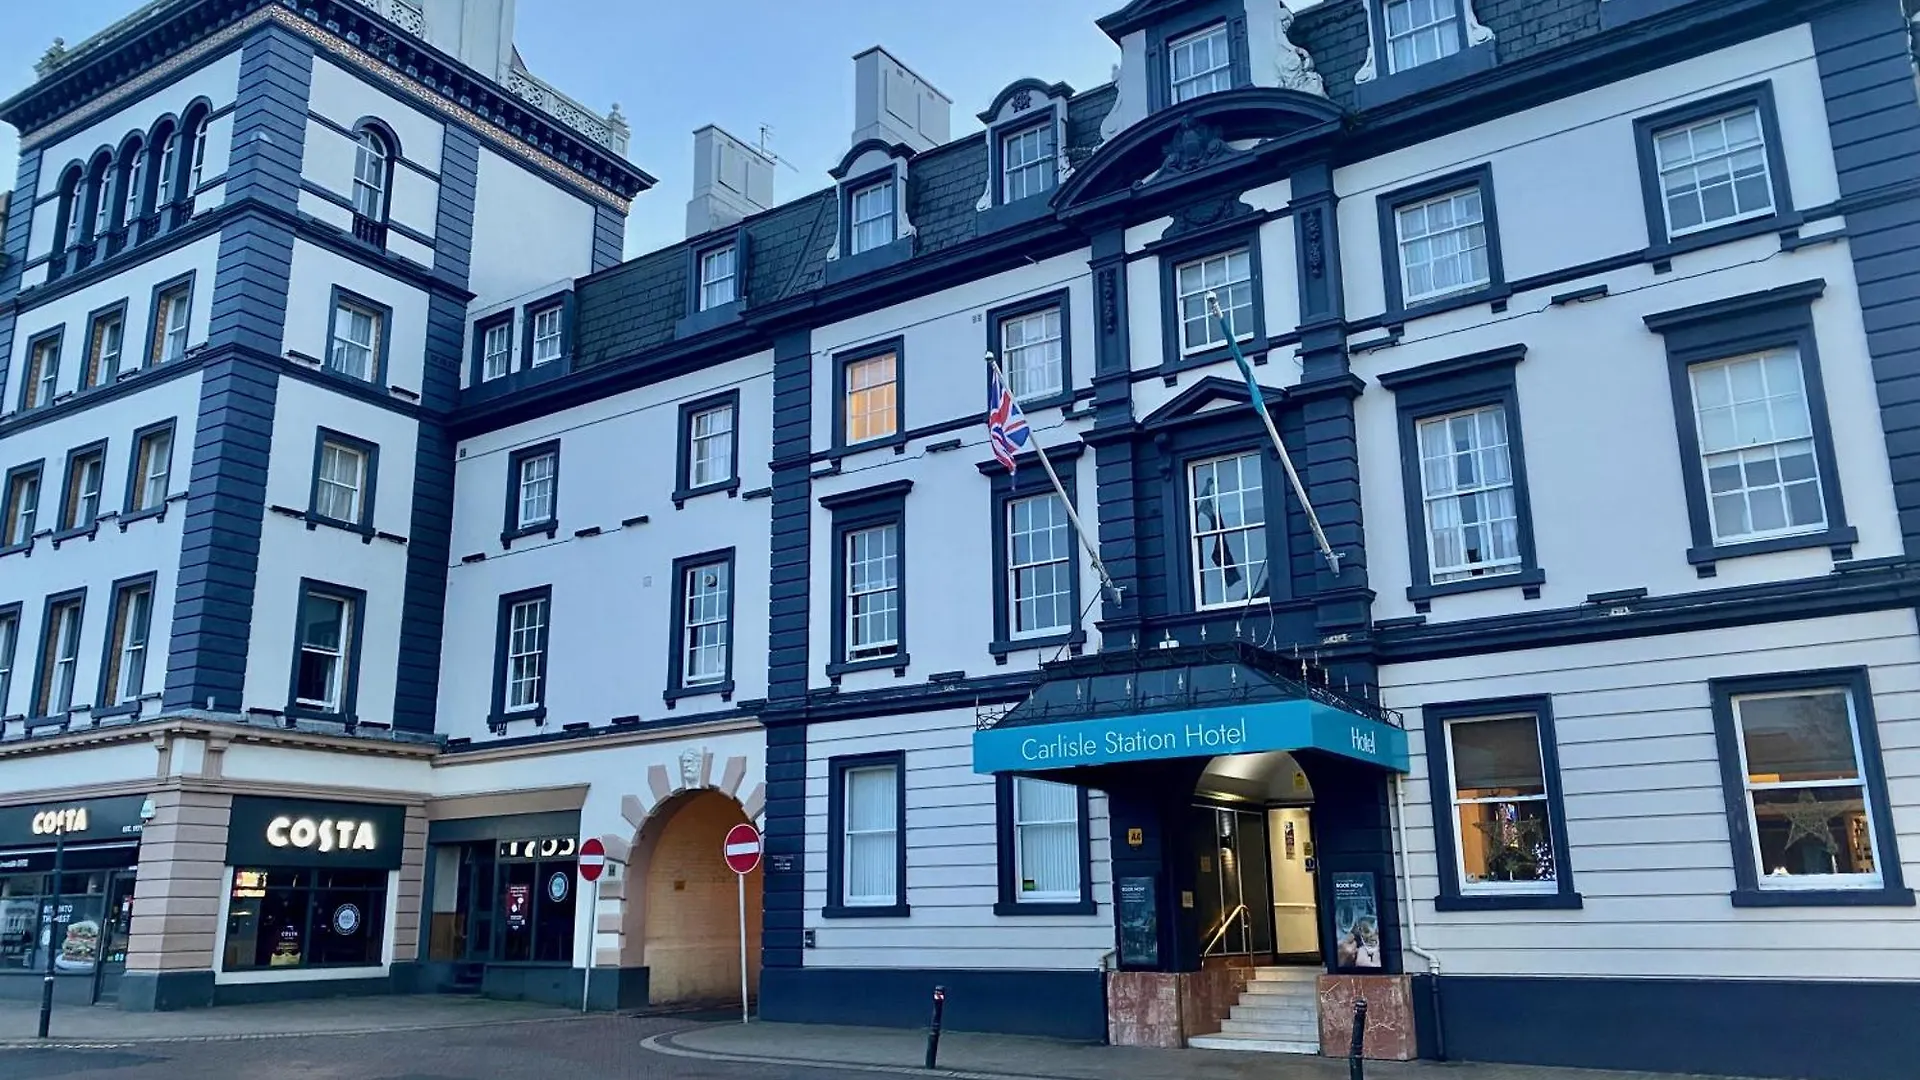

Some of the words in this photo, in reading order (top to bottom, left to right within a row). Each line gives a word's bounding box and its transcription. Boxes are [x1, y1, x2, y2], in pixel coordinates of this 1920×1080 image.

[1021, 732, 1097, 761] Carlisle
[1105, 728, 1176, 754] Station
[1185, 717, 1247, 747] Hotel
[1351, 726, 1376, 755] Hotel
[32, 807, 87, 835] COSTA
[266, 816, 376, 852] COSTA
